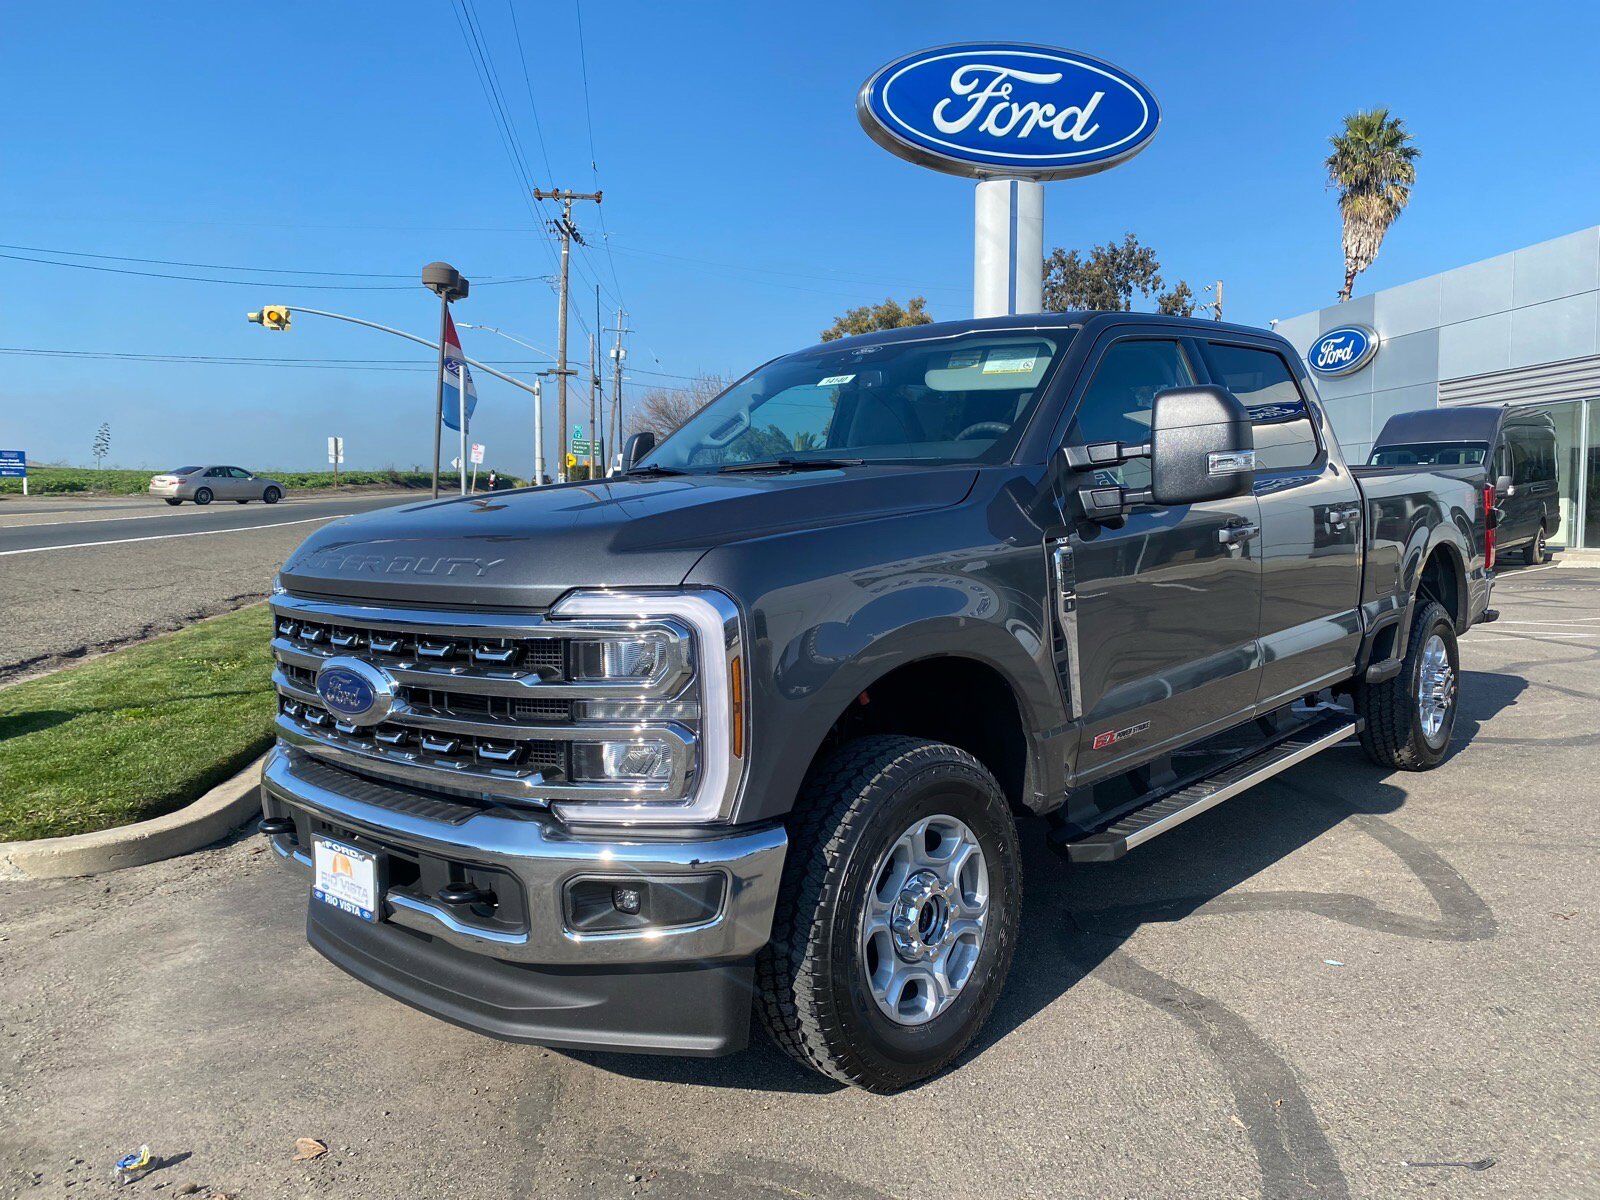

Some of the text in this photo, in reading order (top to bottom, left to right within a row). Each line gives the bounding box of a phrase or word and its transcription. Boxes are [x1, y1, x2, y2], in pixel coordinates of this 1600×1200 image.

[933, 64, 1105, 142] Ford
[1318, 336, 1354, 367] Ford
[1056, 536, 1068, 544] XLT
[385, 555, 505, 577] DUTY
[327, 676, 360, 706] Ford
[325, 840, 358, 858] FORD
[325, 893, 338, 906] RIO
[339, 899, 361, 917] VISTA
